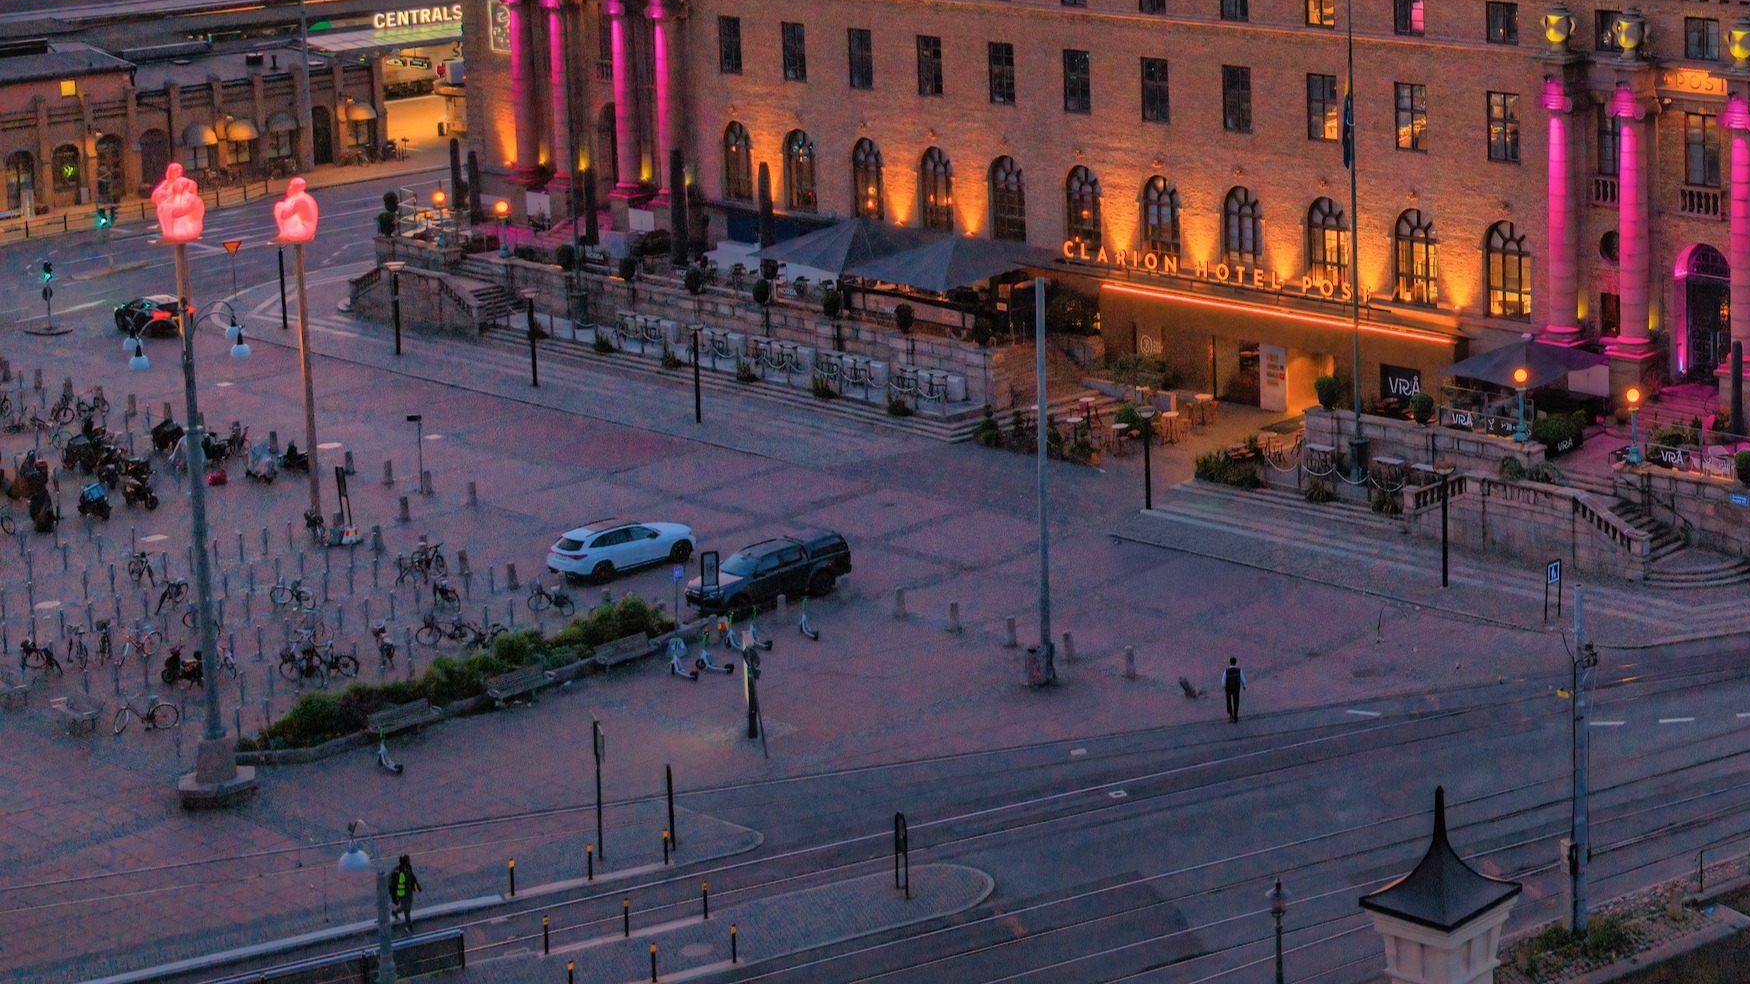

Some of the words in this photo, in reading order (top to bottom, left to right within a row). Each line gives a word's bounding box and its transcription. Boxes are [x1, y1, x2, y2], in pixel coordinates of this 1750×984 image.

[374, 4, 463, 29] CENTRALS
[1063, 240, 1178, 276] CLARION
[1194, 260, 1282, 290] HOTEL
[1302, 276, 1373, 304] POST
[1388, 375, 1421, 396] VRÅ
[1451, 411, 1473, 426] VRÅ
[1557, 435, 1574, 453] VRÅ
[1661, 449, 1684, 465] VRÅ
